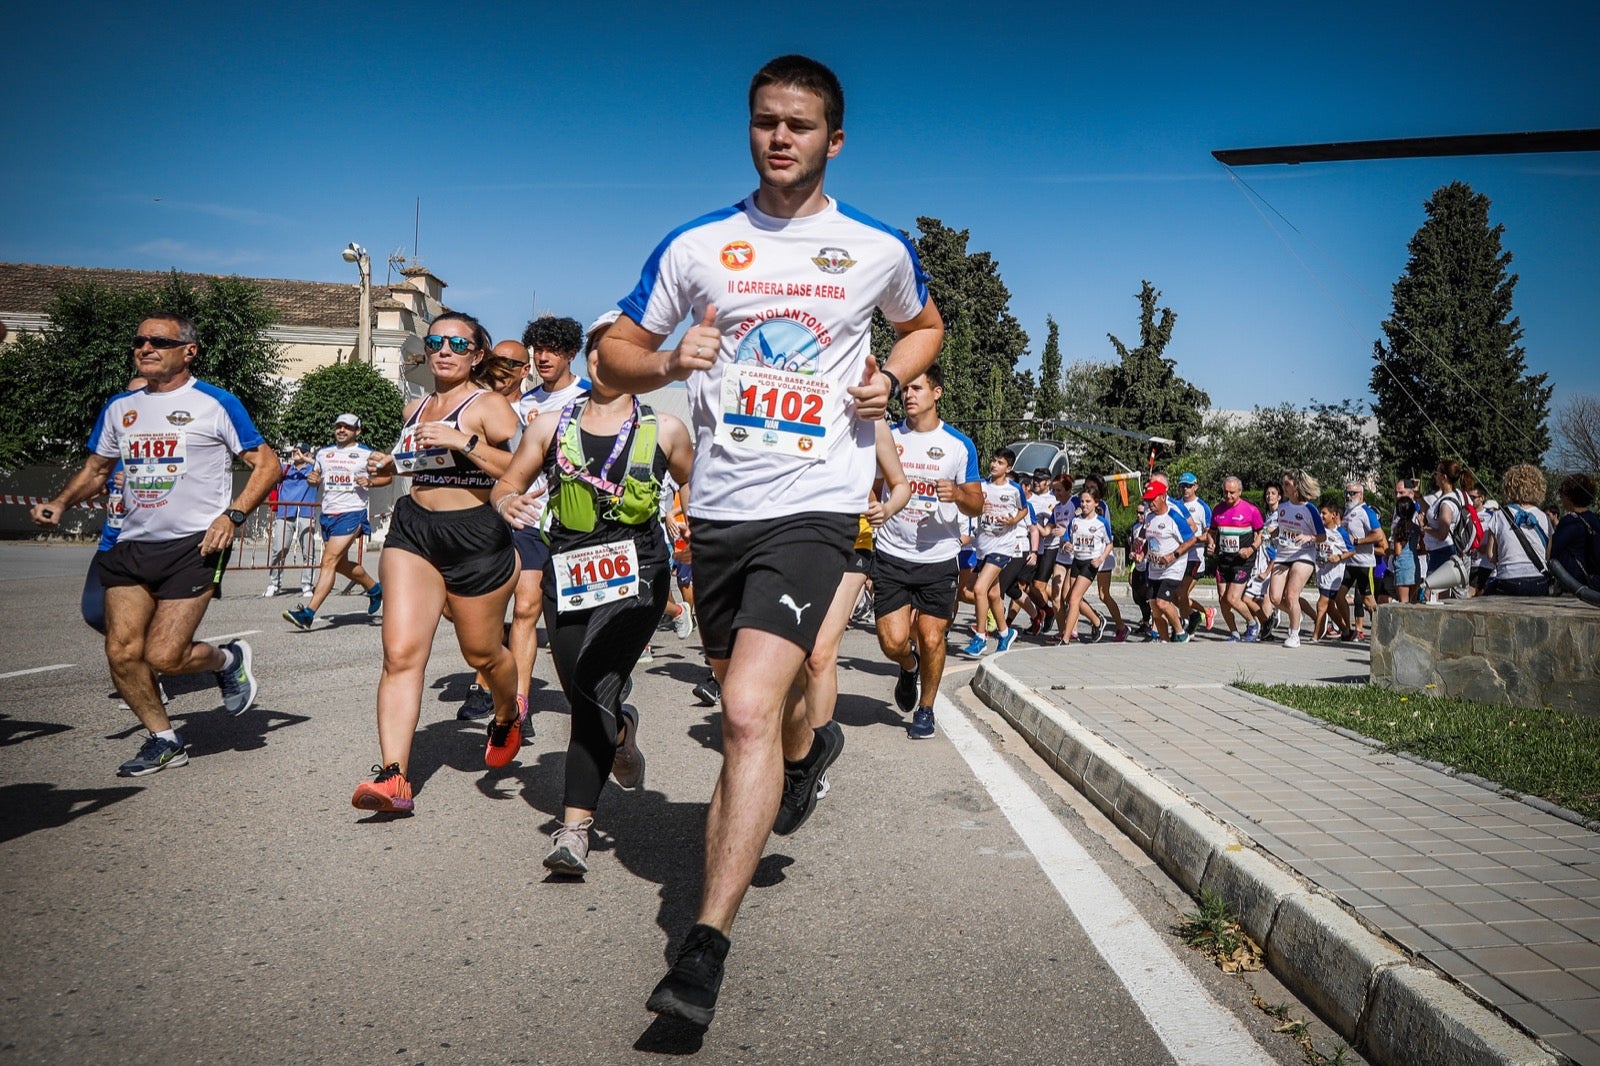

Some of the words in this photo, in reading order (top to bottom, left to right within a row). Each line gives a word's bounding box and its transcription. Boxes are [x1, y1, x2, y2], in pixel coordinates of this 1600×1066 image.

[728, 280, 735, 293] II
[737, 280, 784, 296] CARRERA
[786, 283, 812, 296] BASE
[815, 284, 846, 300] AEREA
[749, 370, 783, 382] CARRERA
[784, 376, 804, 385] BASE
[741, 384, 824, 425] 1102
[130, 440, 178, 459] 1187
[329, 475, 351, 483] 1066
[909, 481, 935, 496] 090
[571, 554, 631, 586] 1106
